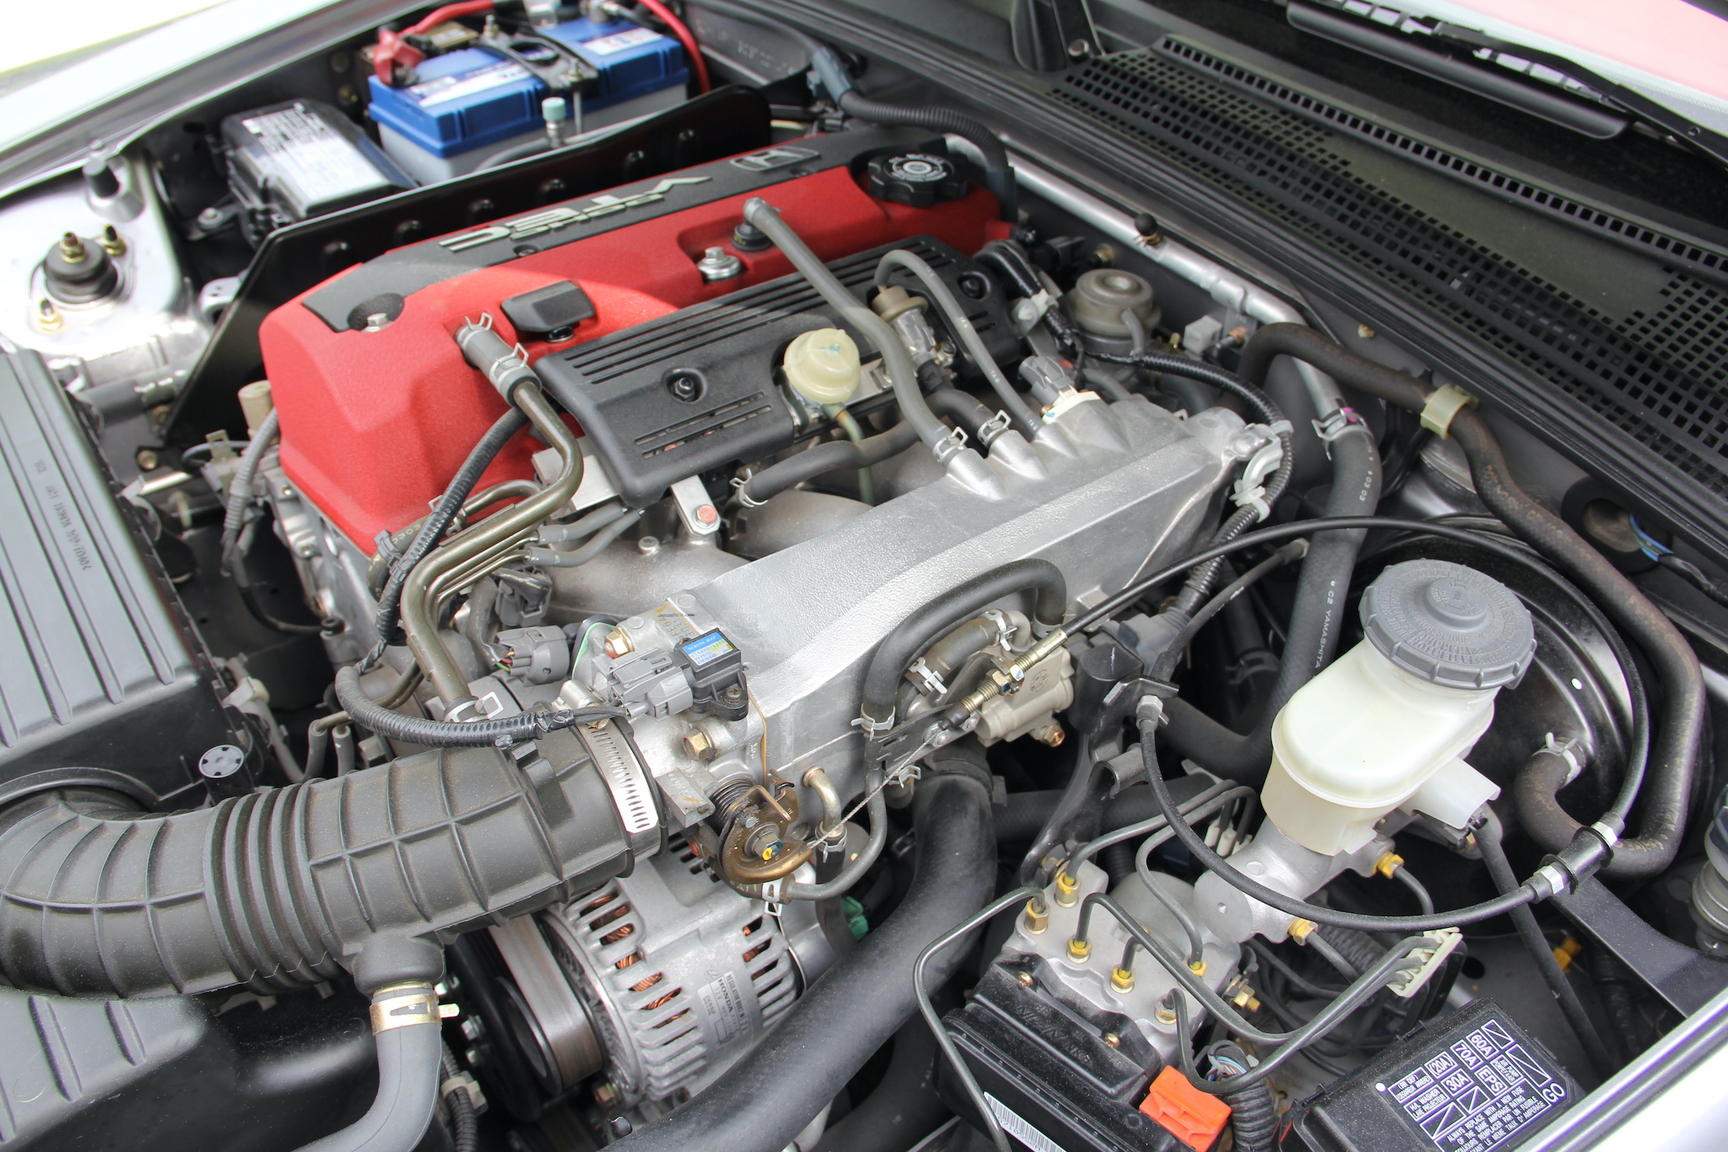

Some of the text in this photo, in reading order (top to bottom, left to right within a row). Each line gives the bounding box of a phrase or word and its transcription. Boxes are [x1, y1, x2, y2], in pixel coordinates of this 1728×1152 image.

[439, 176, 712, 252] VTEC
[1315, 609, 1332, 668] YAMASHITA
[718, 978, 734, 1013] HONDA
[1455, 1043, 1477, 1066] 70A
[1471, 1034, 1493, 1056] 60A
[1429, 1054, 1453, 1076] (20A)
[1446, 1073, 1470, 1091] 30A
[1478, 1067, 1503, 1092] EPS
[1419, 1088, 1441, 1104] WASHER
[1542, 1082, 1565, 1103] GO
[1447, 1127, 1465, 1142] ALWAYS
[1464, 1114, 1485, 1130] REPLACE
[1483, 1105, 1497, 1116] WITH
[1500, 1094, 1512, 1105] NEW
[1512, 1086, 1525, 1097] FUSE
[1457, 1095, 1526, 1145] OF THE SAME AMPERAGE RATING
[1478, 1120, 1503, 1141] REMPLACER
[1502, 1114, 1513, 1124] PAR
[1512, 1108, 1521, 1116] UN
[1520, 1096, 1538, 1110] FUSIBLE
[1484, 1138, 1493, 1146] LE
[1505, 1120, 1518, 1131] TAUX
